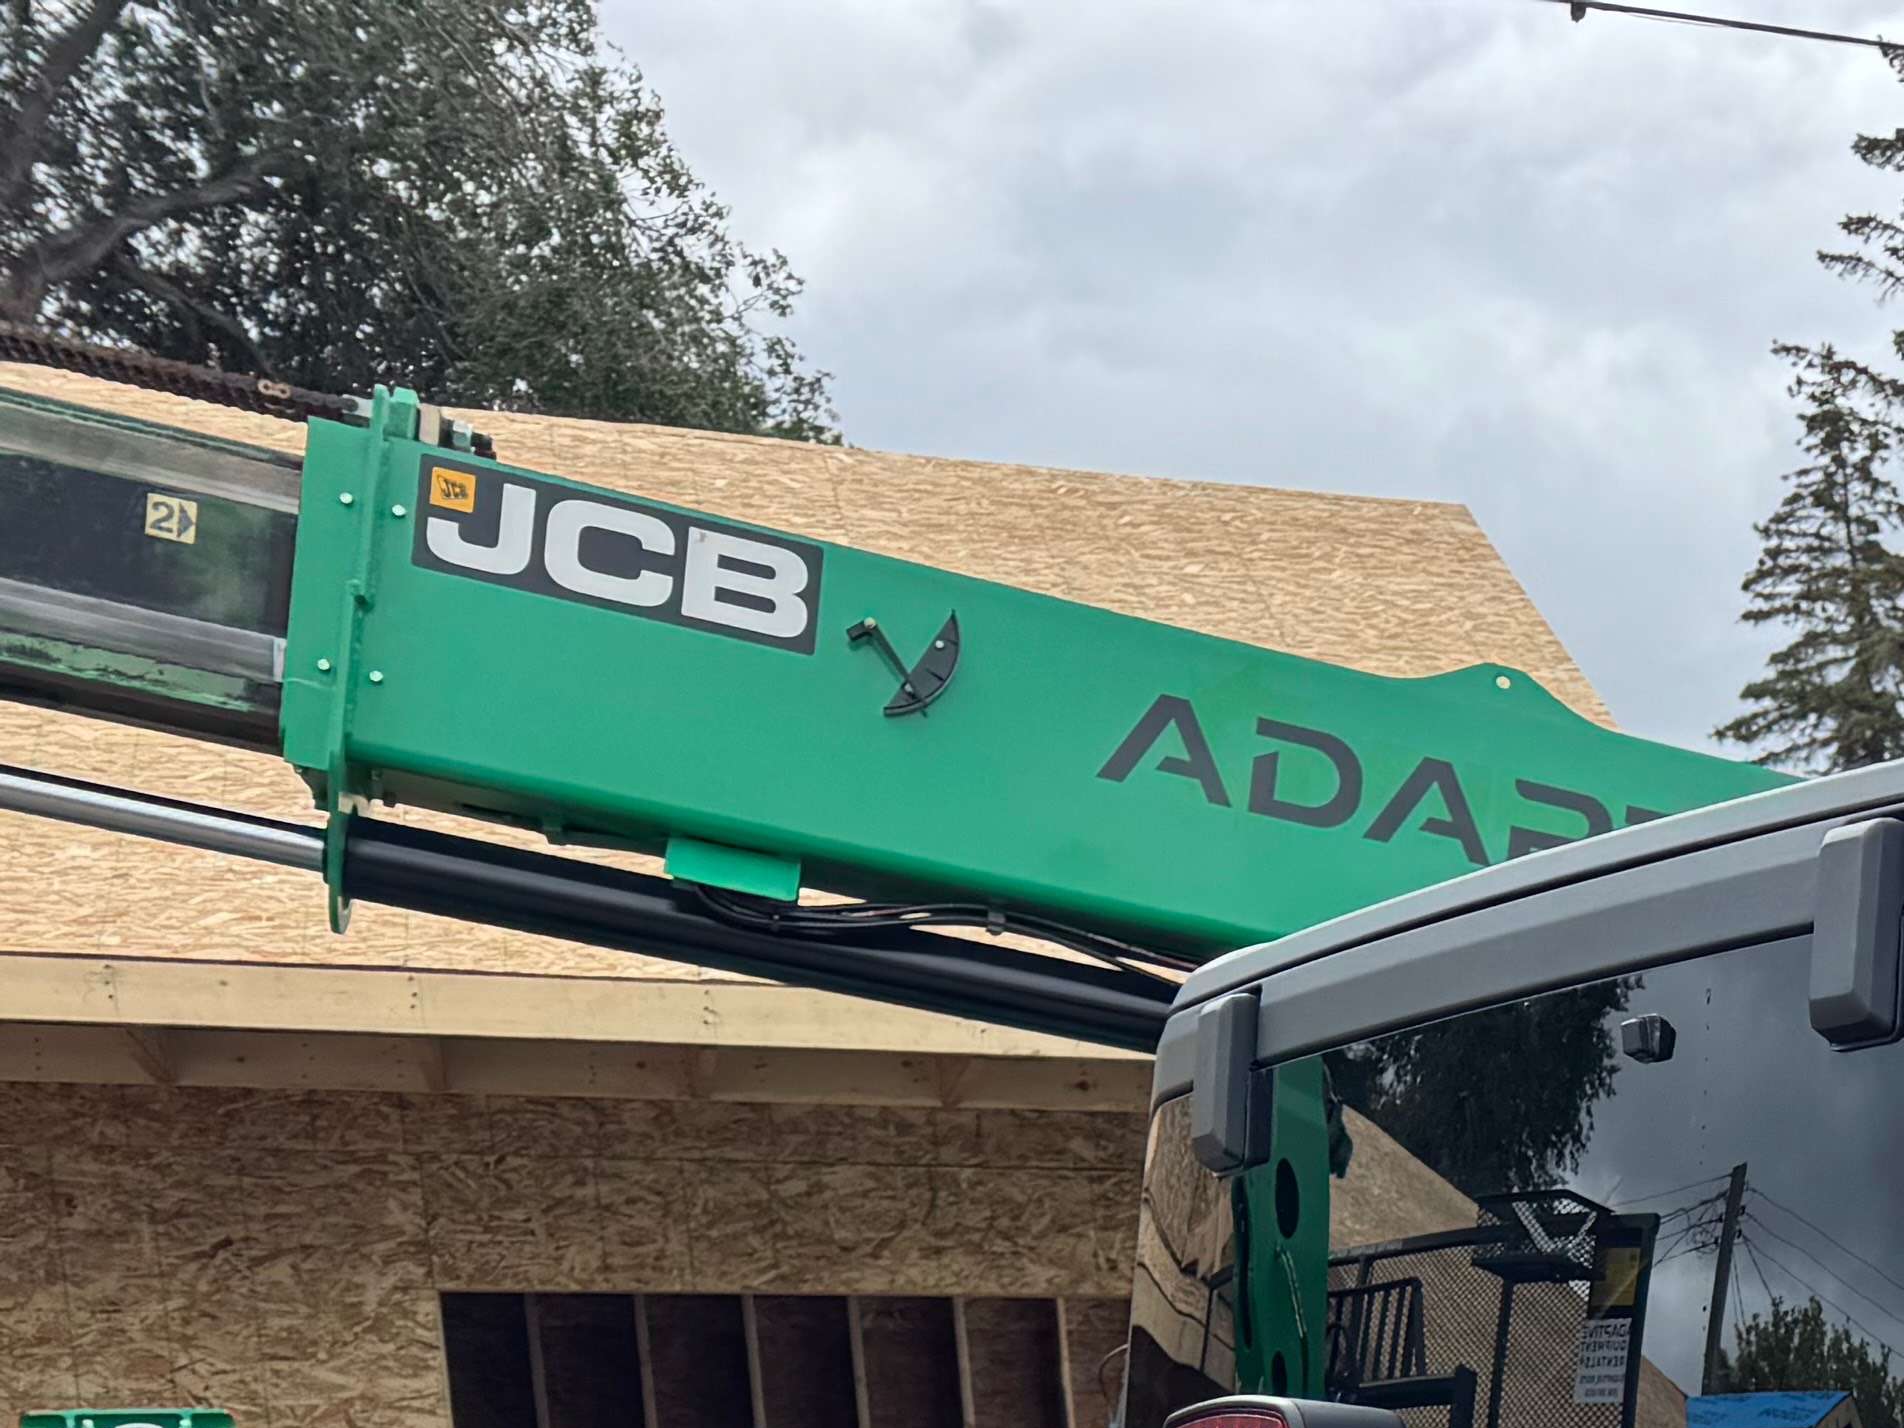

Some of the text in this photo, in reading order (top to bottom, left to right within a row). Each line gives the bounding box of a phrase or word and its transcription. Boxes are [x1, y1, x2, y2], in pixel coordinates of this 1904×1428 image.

[149, 500, 176, 534] 2
[426, 482, 809, 638] JCB
[1096, 693, 1665, 867] ADAP
